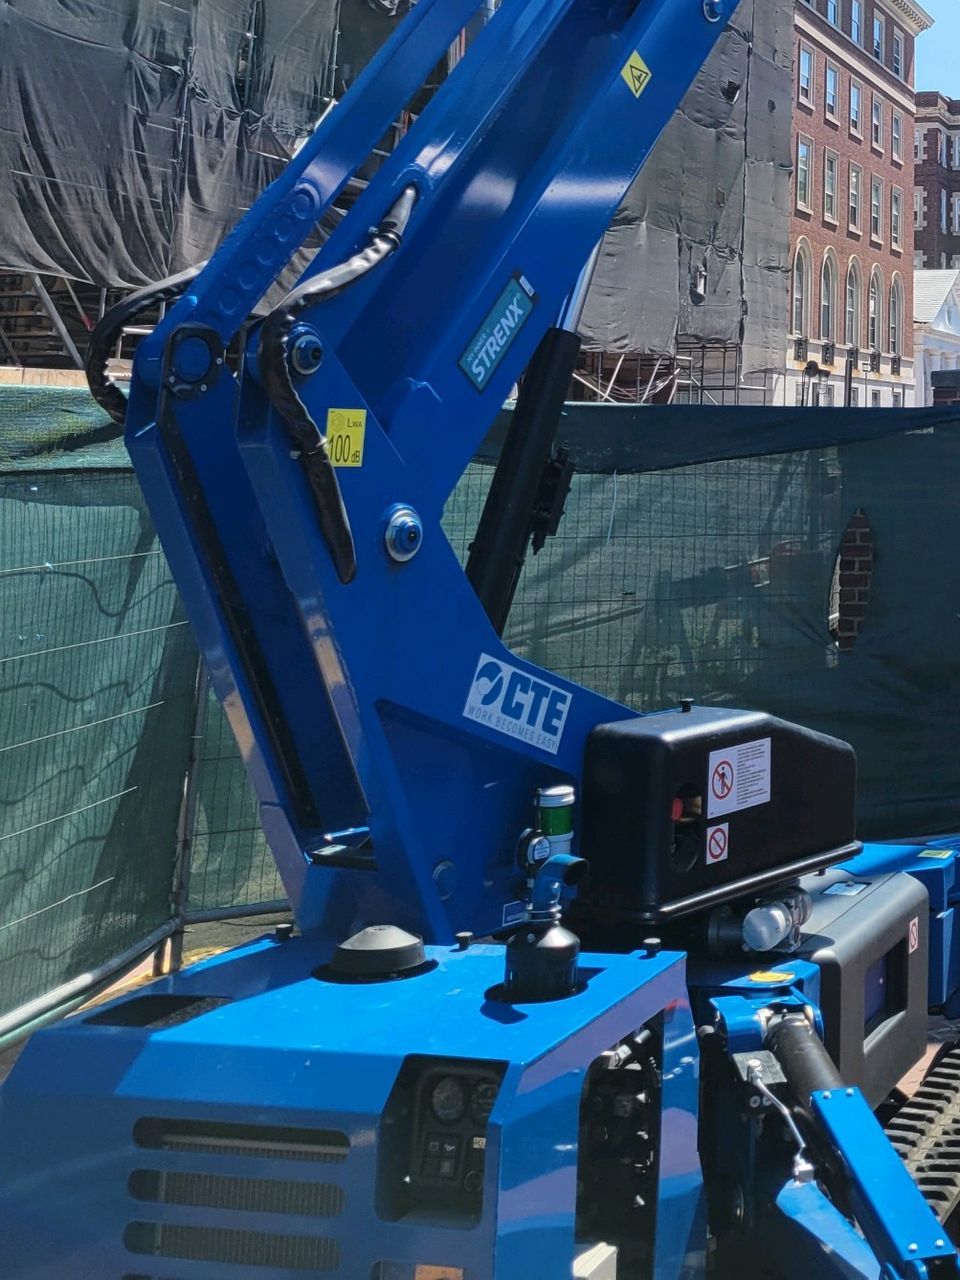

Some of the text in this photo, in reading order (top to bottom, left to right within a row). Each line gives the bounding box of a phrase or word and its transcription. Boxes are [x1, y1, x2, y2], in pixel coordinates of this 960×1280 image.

[472, 297, 524, 382] STRENX
[328, 434, 361, 463] 100 dB
[467, 704, 493, 724] WORK
[495, 715, 537, 741] BECOMES
[501, 671, 568, 737] CTE
